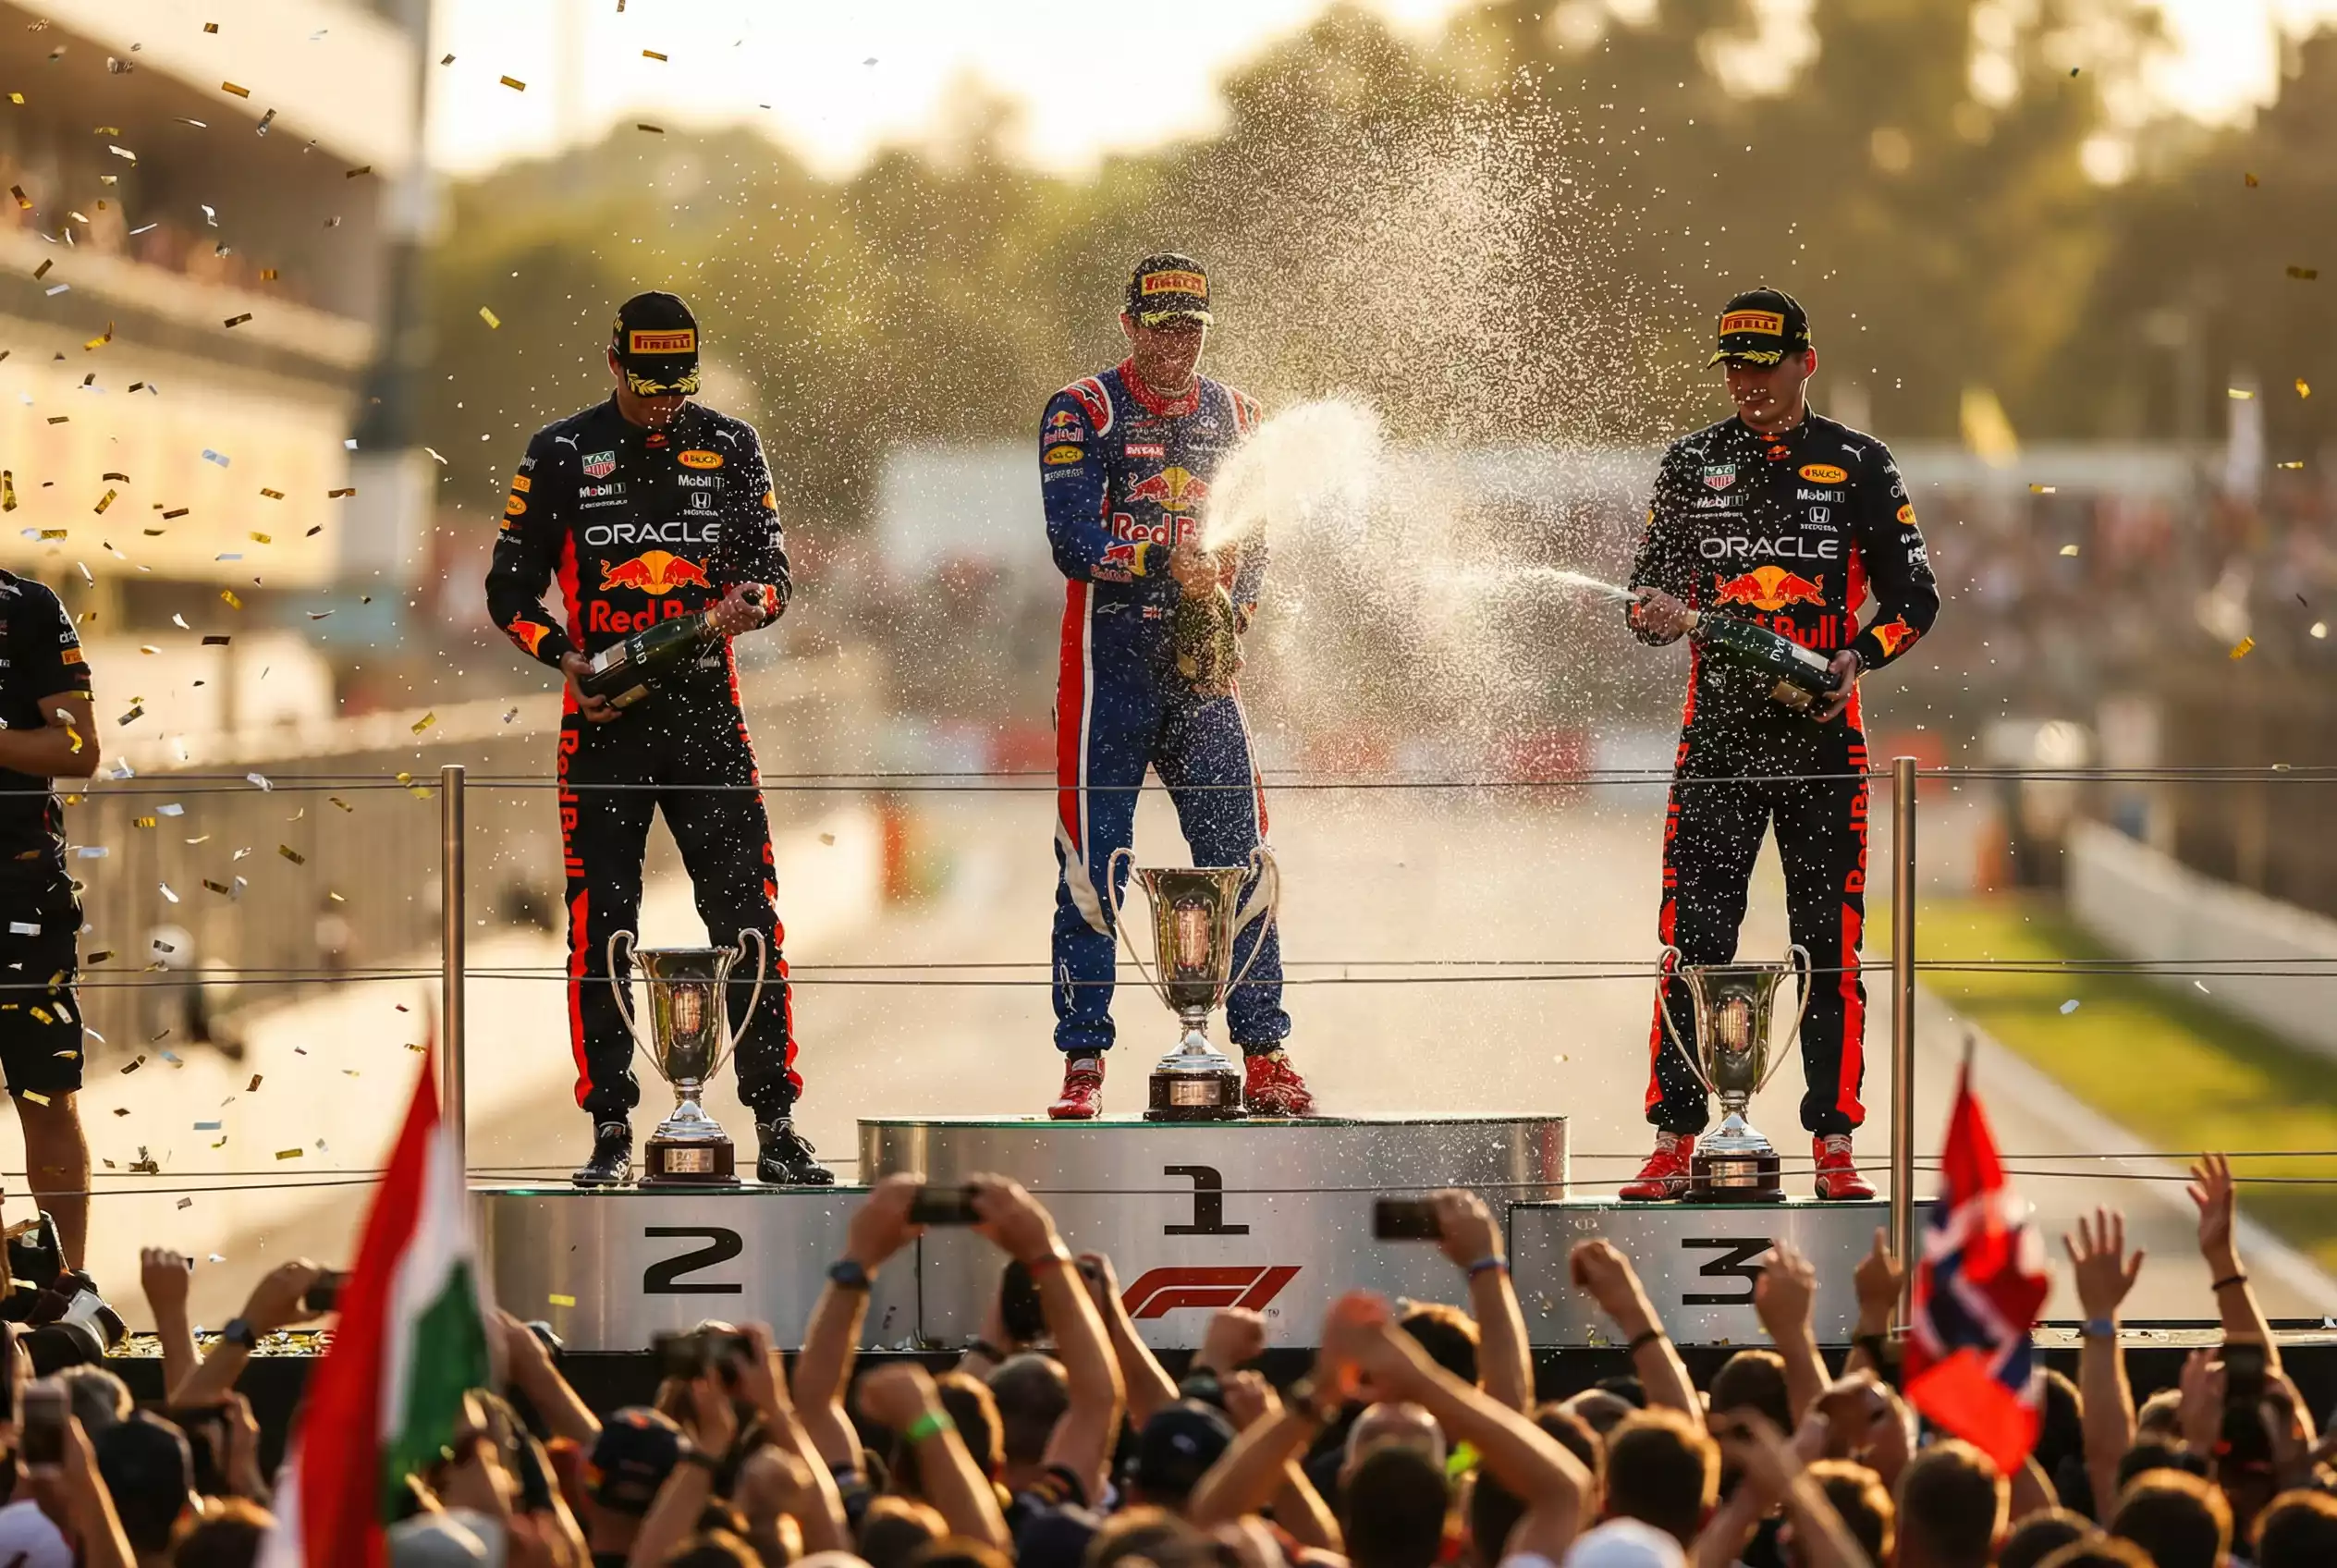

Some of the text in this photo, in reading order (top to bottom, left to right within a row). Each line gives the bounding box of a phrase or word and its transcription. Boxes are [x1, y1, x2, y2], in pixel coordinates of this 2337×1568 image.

[633, 334, 691, 349] PIRELLI
[584, 521, 722, 545] ORACLE
[1112, 512, 1172, 546] Red
[1699, 536, 1840, 559] ORACLE
[590, 600, 655, 632] Red
[1774, 615, 1838, 649] Bull
[1164, 1166, 1250, 1235] 1
[643, 1227, 743, 1294] 2
[1682, 1238, 1775, 1305] 3
